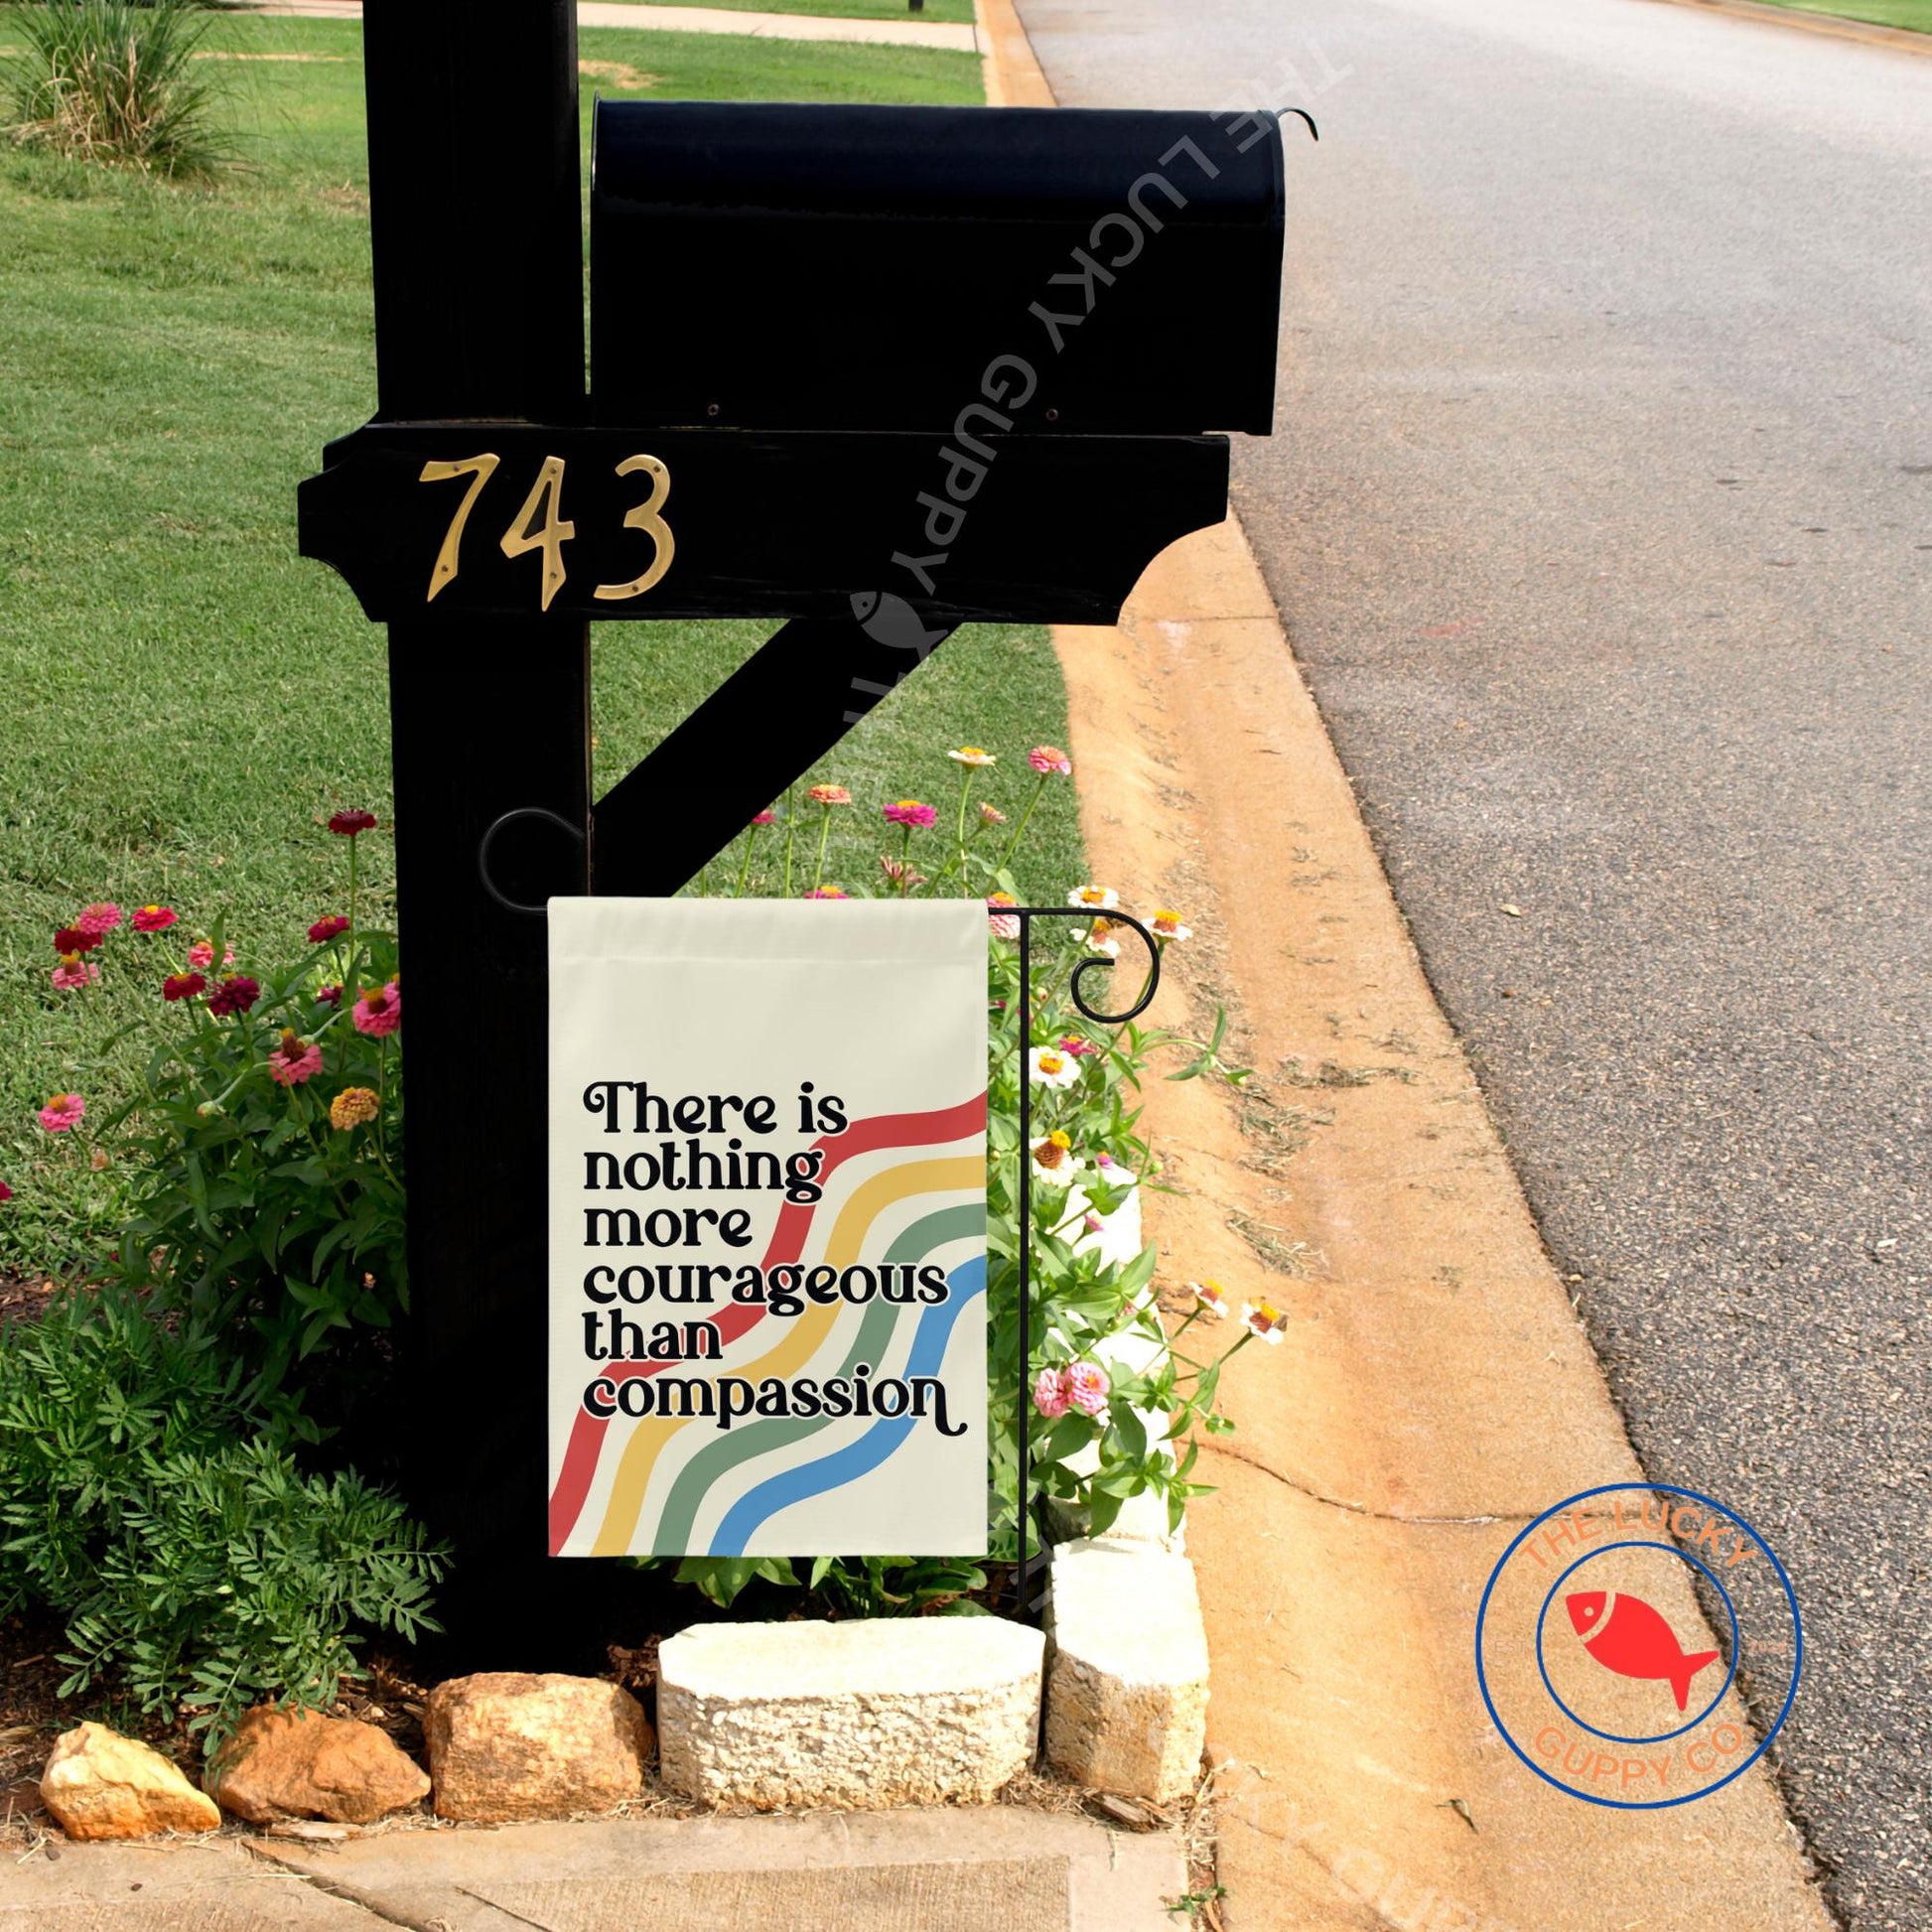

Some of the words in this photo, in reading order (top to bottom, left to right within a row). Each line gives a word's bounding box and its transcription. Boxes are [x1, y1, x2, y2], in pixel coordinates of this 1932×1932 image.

[418, 453, 676, 613] 743
[583, 1081, 777, 1134] There
[798, 1081, 848, 1134] is
[583, 1138, 824, 1204] nothing
[583, 1208, 754, 1248] more
[583, 1264, 949, 1317] courageous
[582, 1308, 724, 1360] than
[583, 1364, 969, 1438] compassion
